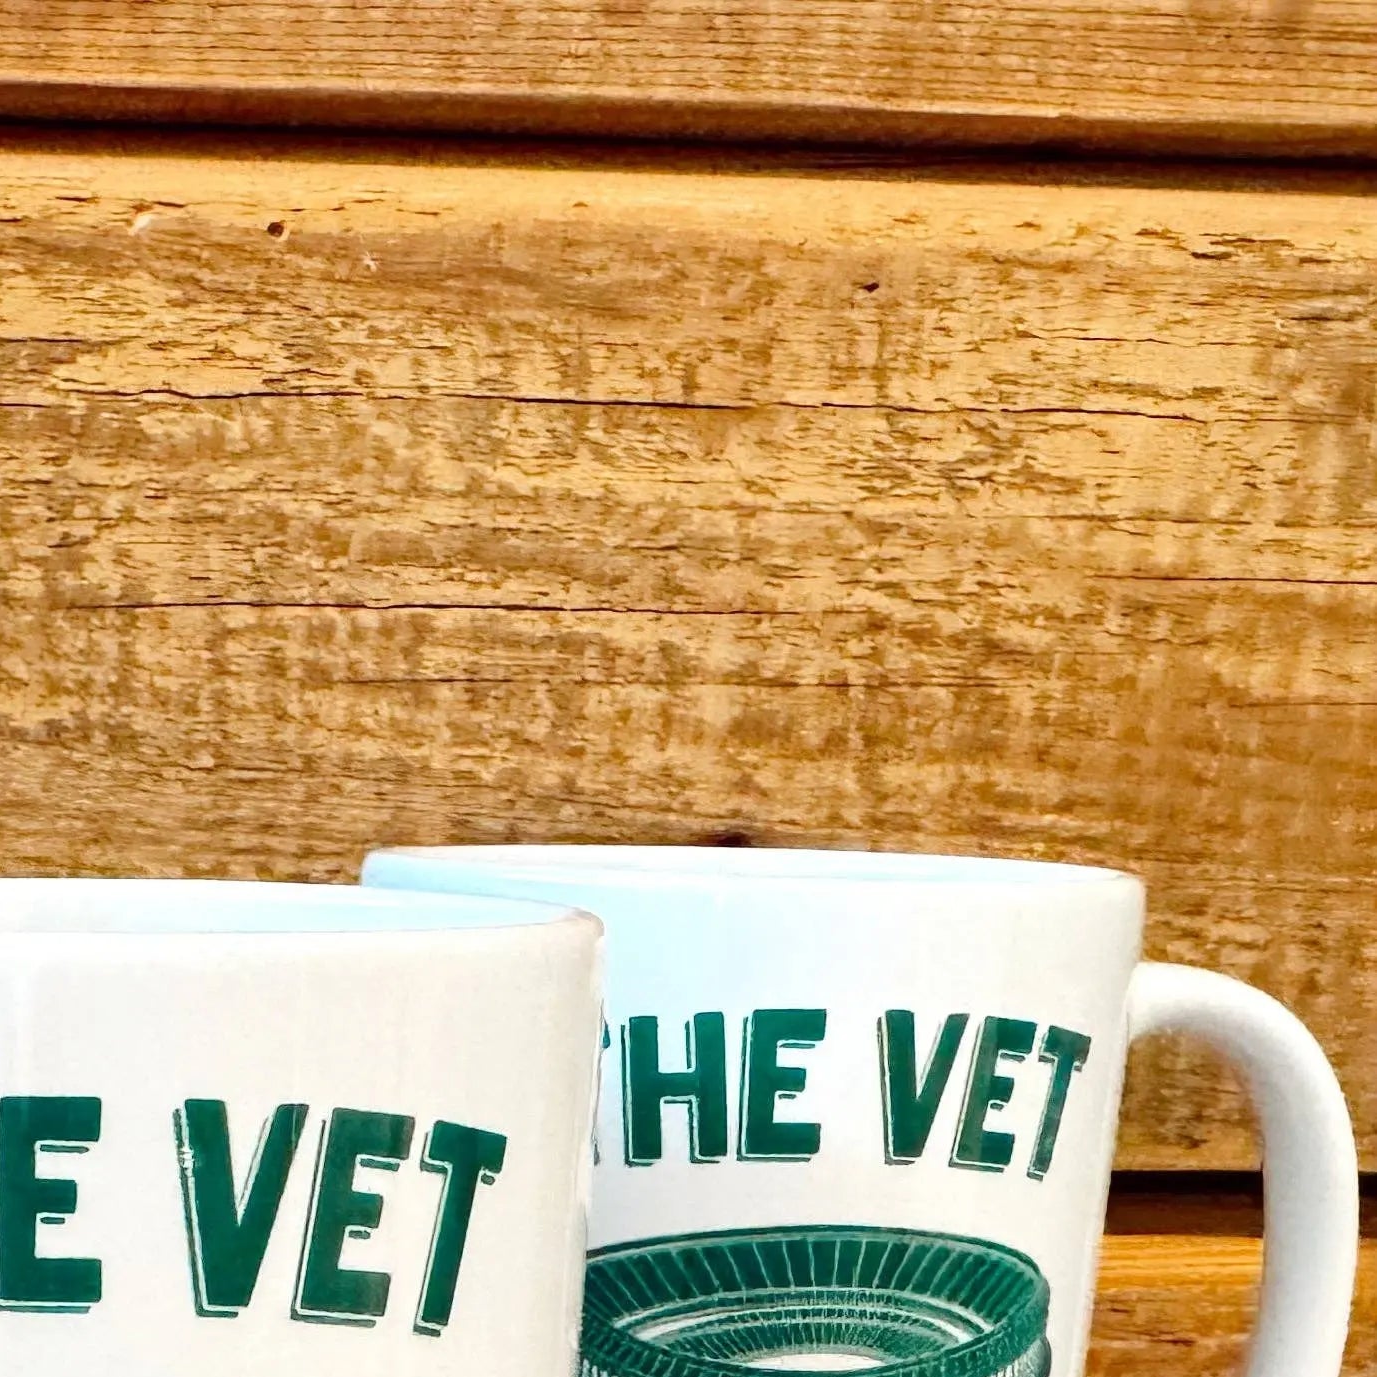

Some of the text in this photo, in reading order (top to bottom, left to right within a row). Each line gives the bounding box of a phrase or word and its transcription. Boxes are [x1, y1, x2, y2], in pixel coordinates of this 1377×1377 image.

[595, 1008, 1093, 1181] HE VET
[173, 1097, 508, 1338] VET
